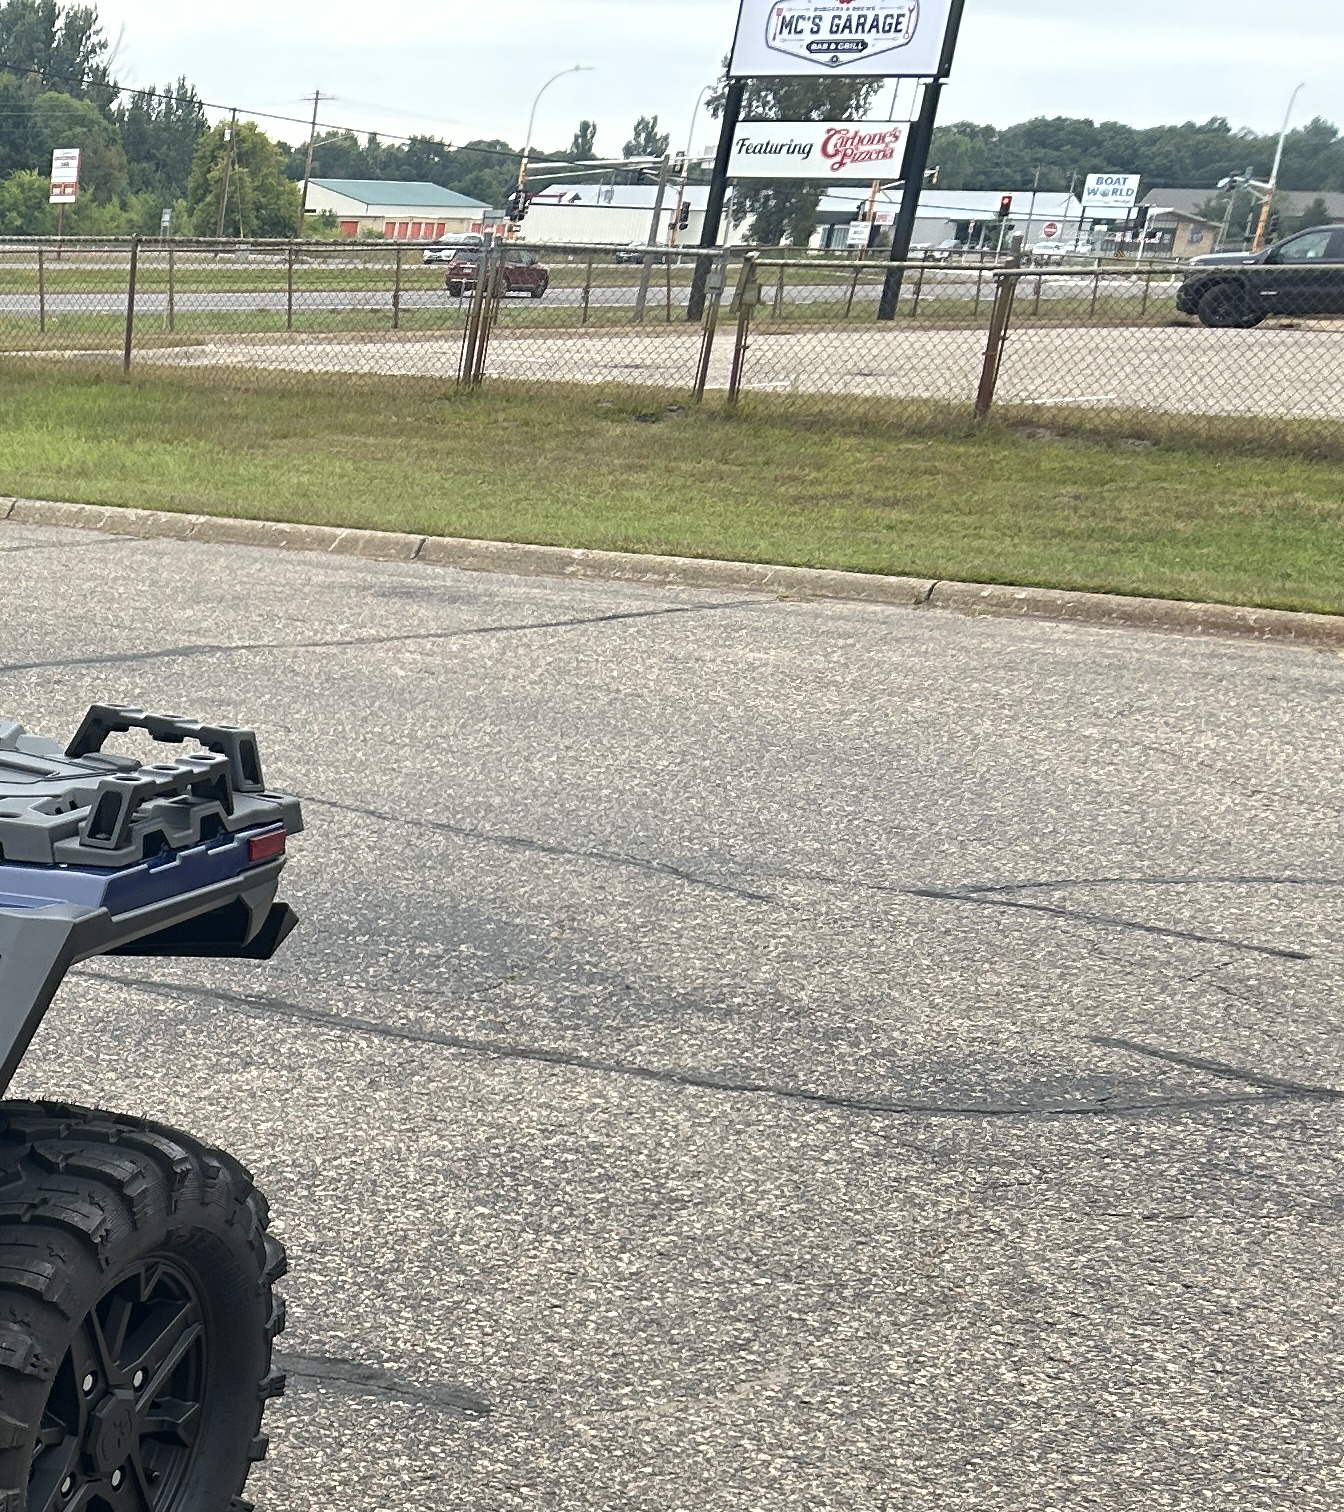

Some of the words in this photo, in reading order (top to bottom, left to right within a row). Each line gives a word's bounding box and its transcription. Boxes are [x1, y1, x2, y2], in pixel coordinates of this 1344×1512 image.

[778, 13, 823, 36] MC'S
[829, 12, 906, 36] GARAGE
[837, 41, 865, 50] GRILL
[735, 137, 814, 160] Featuring
[1095, 176, 1129, 186] BOAT
